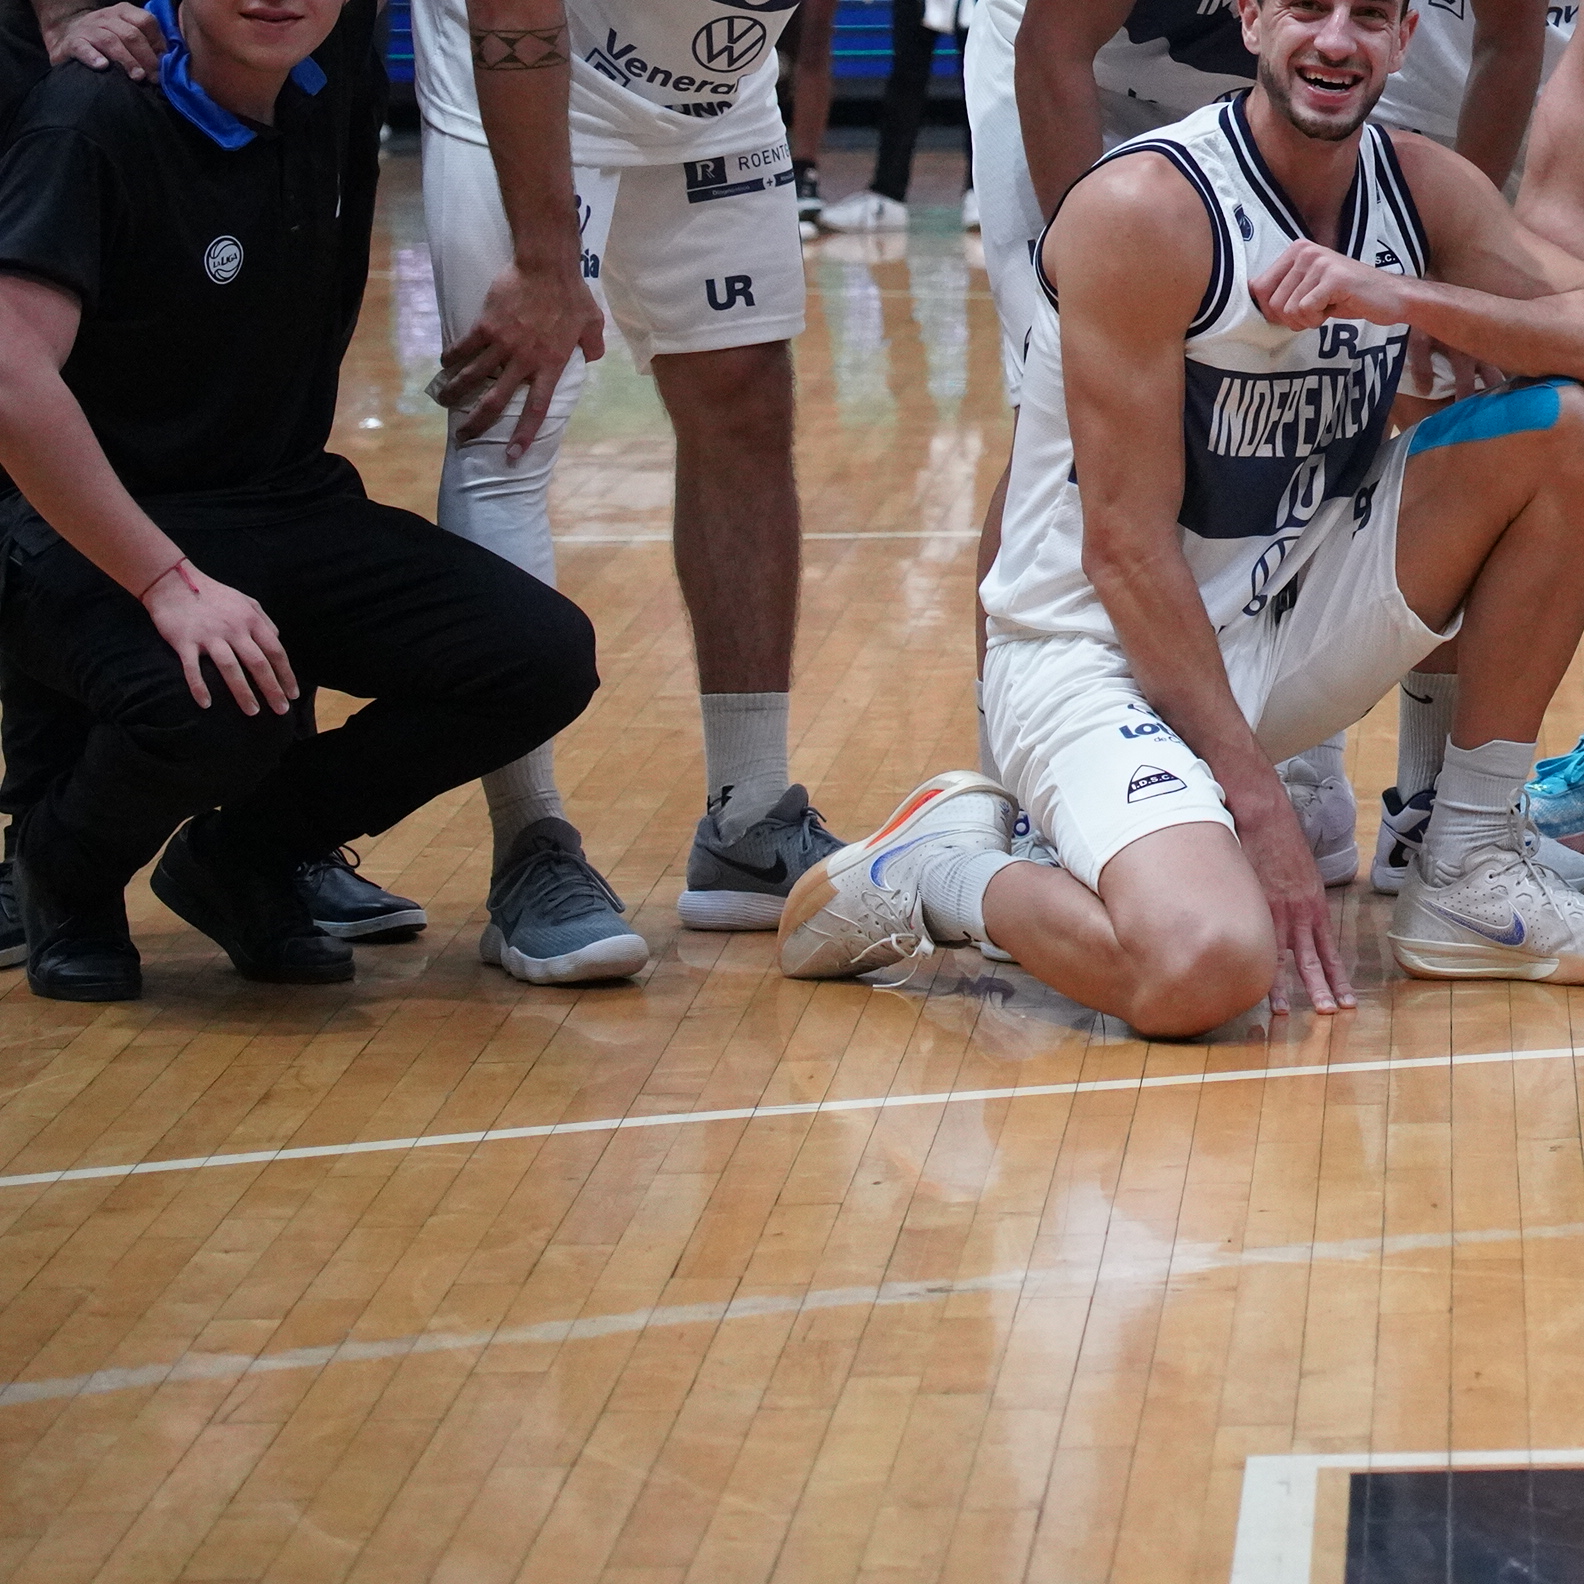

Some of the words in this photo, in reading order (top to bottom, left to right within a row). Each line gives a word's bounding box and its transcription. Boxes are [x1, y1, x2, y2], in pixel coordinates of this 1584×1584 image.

[607, 28, 738, 96] Venera
[738, 146, 790, 170] ROENT
[705, 273, 756, 311] UR
[1318, 323, 1359, 360] UR
[1131, 773, 1175, 790] I.D.S.C.
